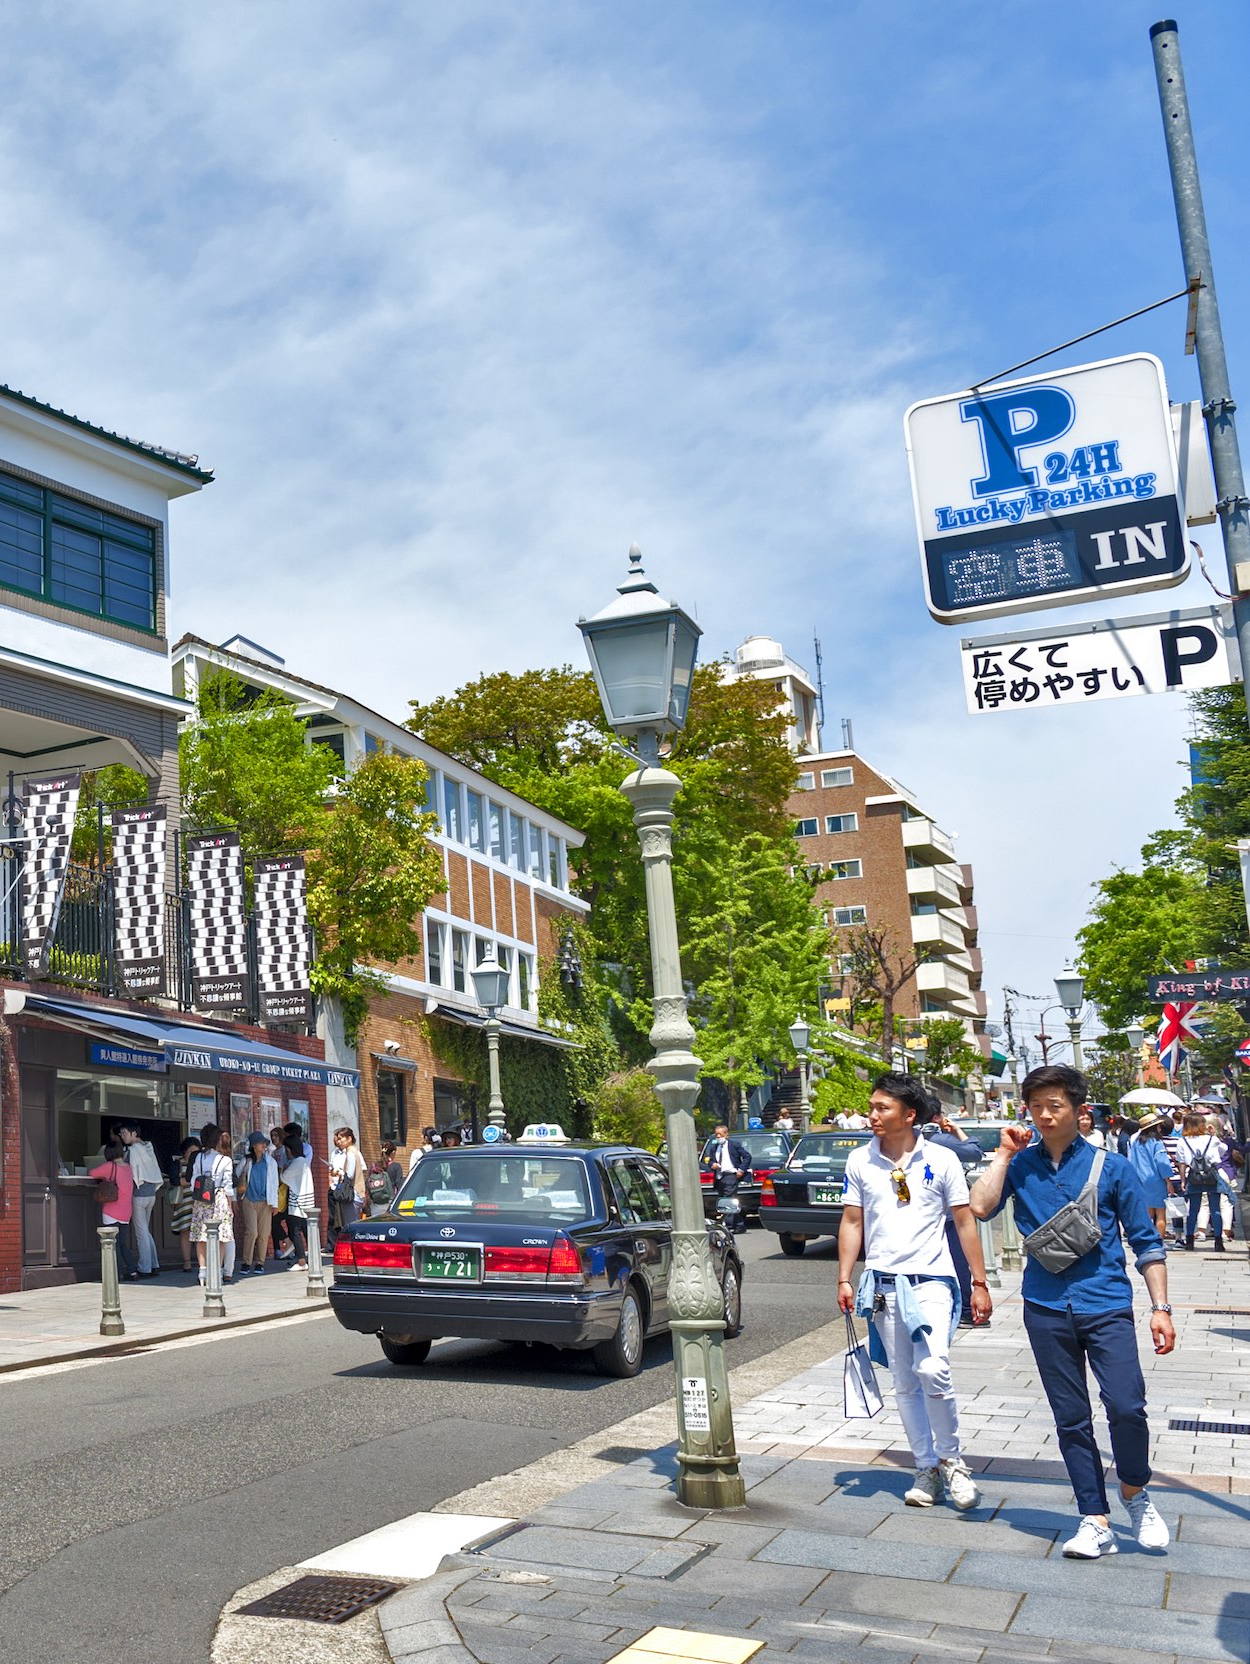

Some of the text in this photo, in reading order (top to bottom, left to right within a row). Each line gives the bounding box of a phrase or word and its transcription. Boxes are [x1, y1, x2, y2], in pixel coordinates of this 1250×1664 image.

[959, 385, 1076, 499] P
[1043, 440, 1122, 485] 24H
[1090, 521, 1168, 570] IN
[972, 642, 1069, 679] 広くて
[1159, 625, 1218, 687] P
[974, 665, 1145, 709] 停めやすい
[1157, 980, 1196, 996] King
[1204, 977, 1223, 996] of
[261, 1063, 281, 1074] GROUP
[281, 1066, 303, 1079] TICKET
[303, 1069, 321, 1080] PLAZA
